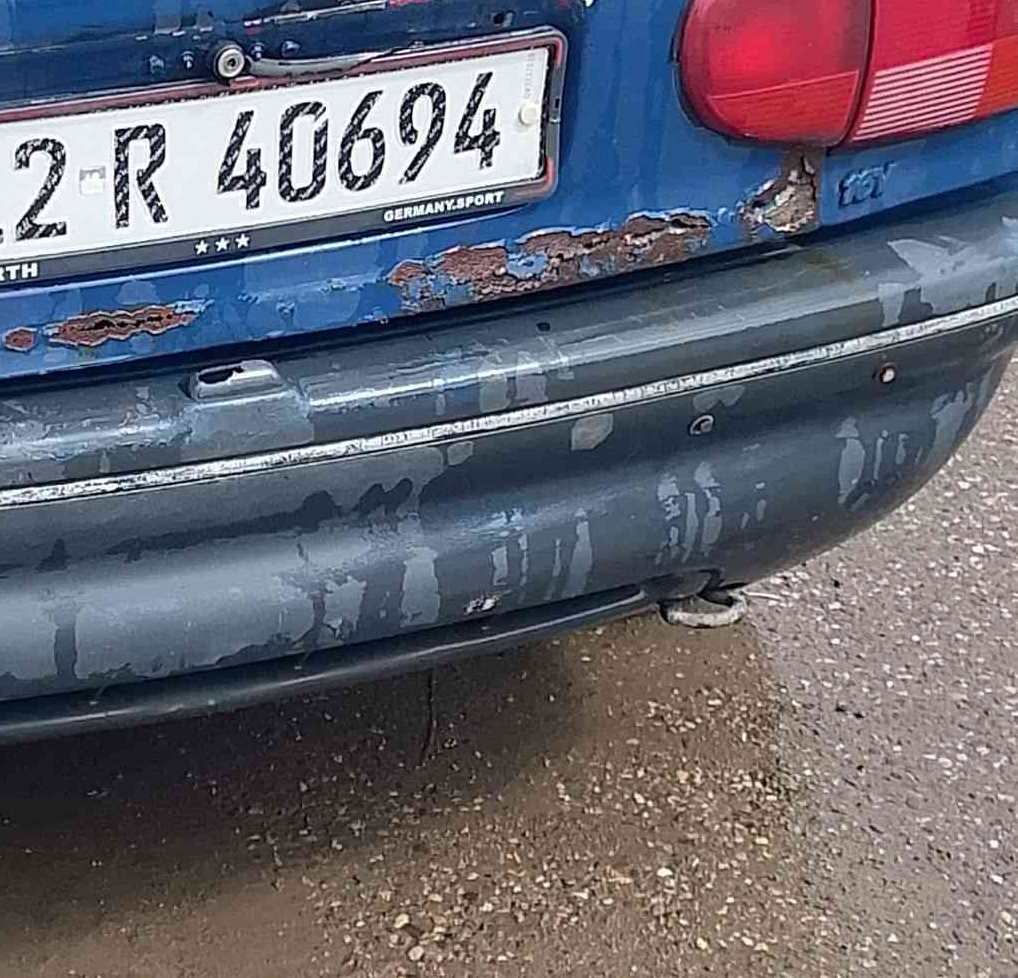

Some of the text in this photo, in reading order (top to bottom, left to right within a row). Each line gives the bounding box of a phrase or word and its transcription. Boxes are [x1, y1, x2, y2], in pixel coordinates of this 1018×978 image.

[114, 123, 169, 229] R
[216, 71, 501, 210] 40694
[383, 190, 505, 222] GERMANY.SPORT
